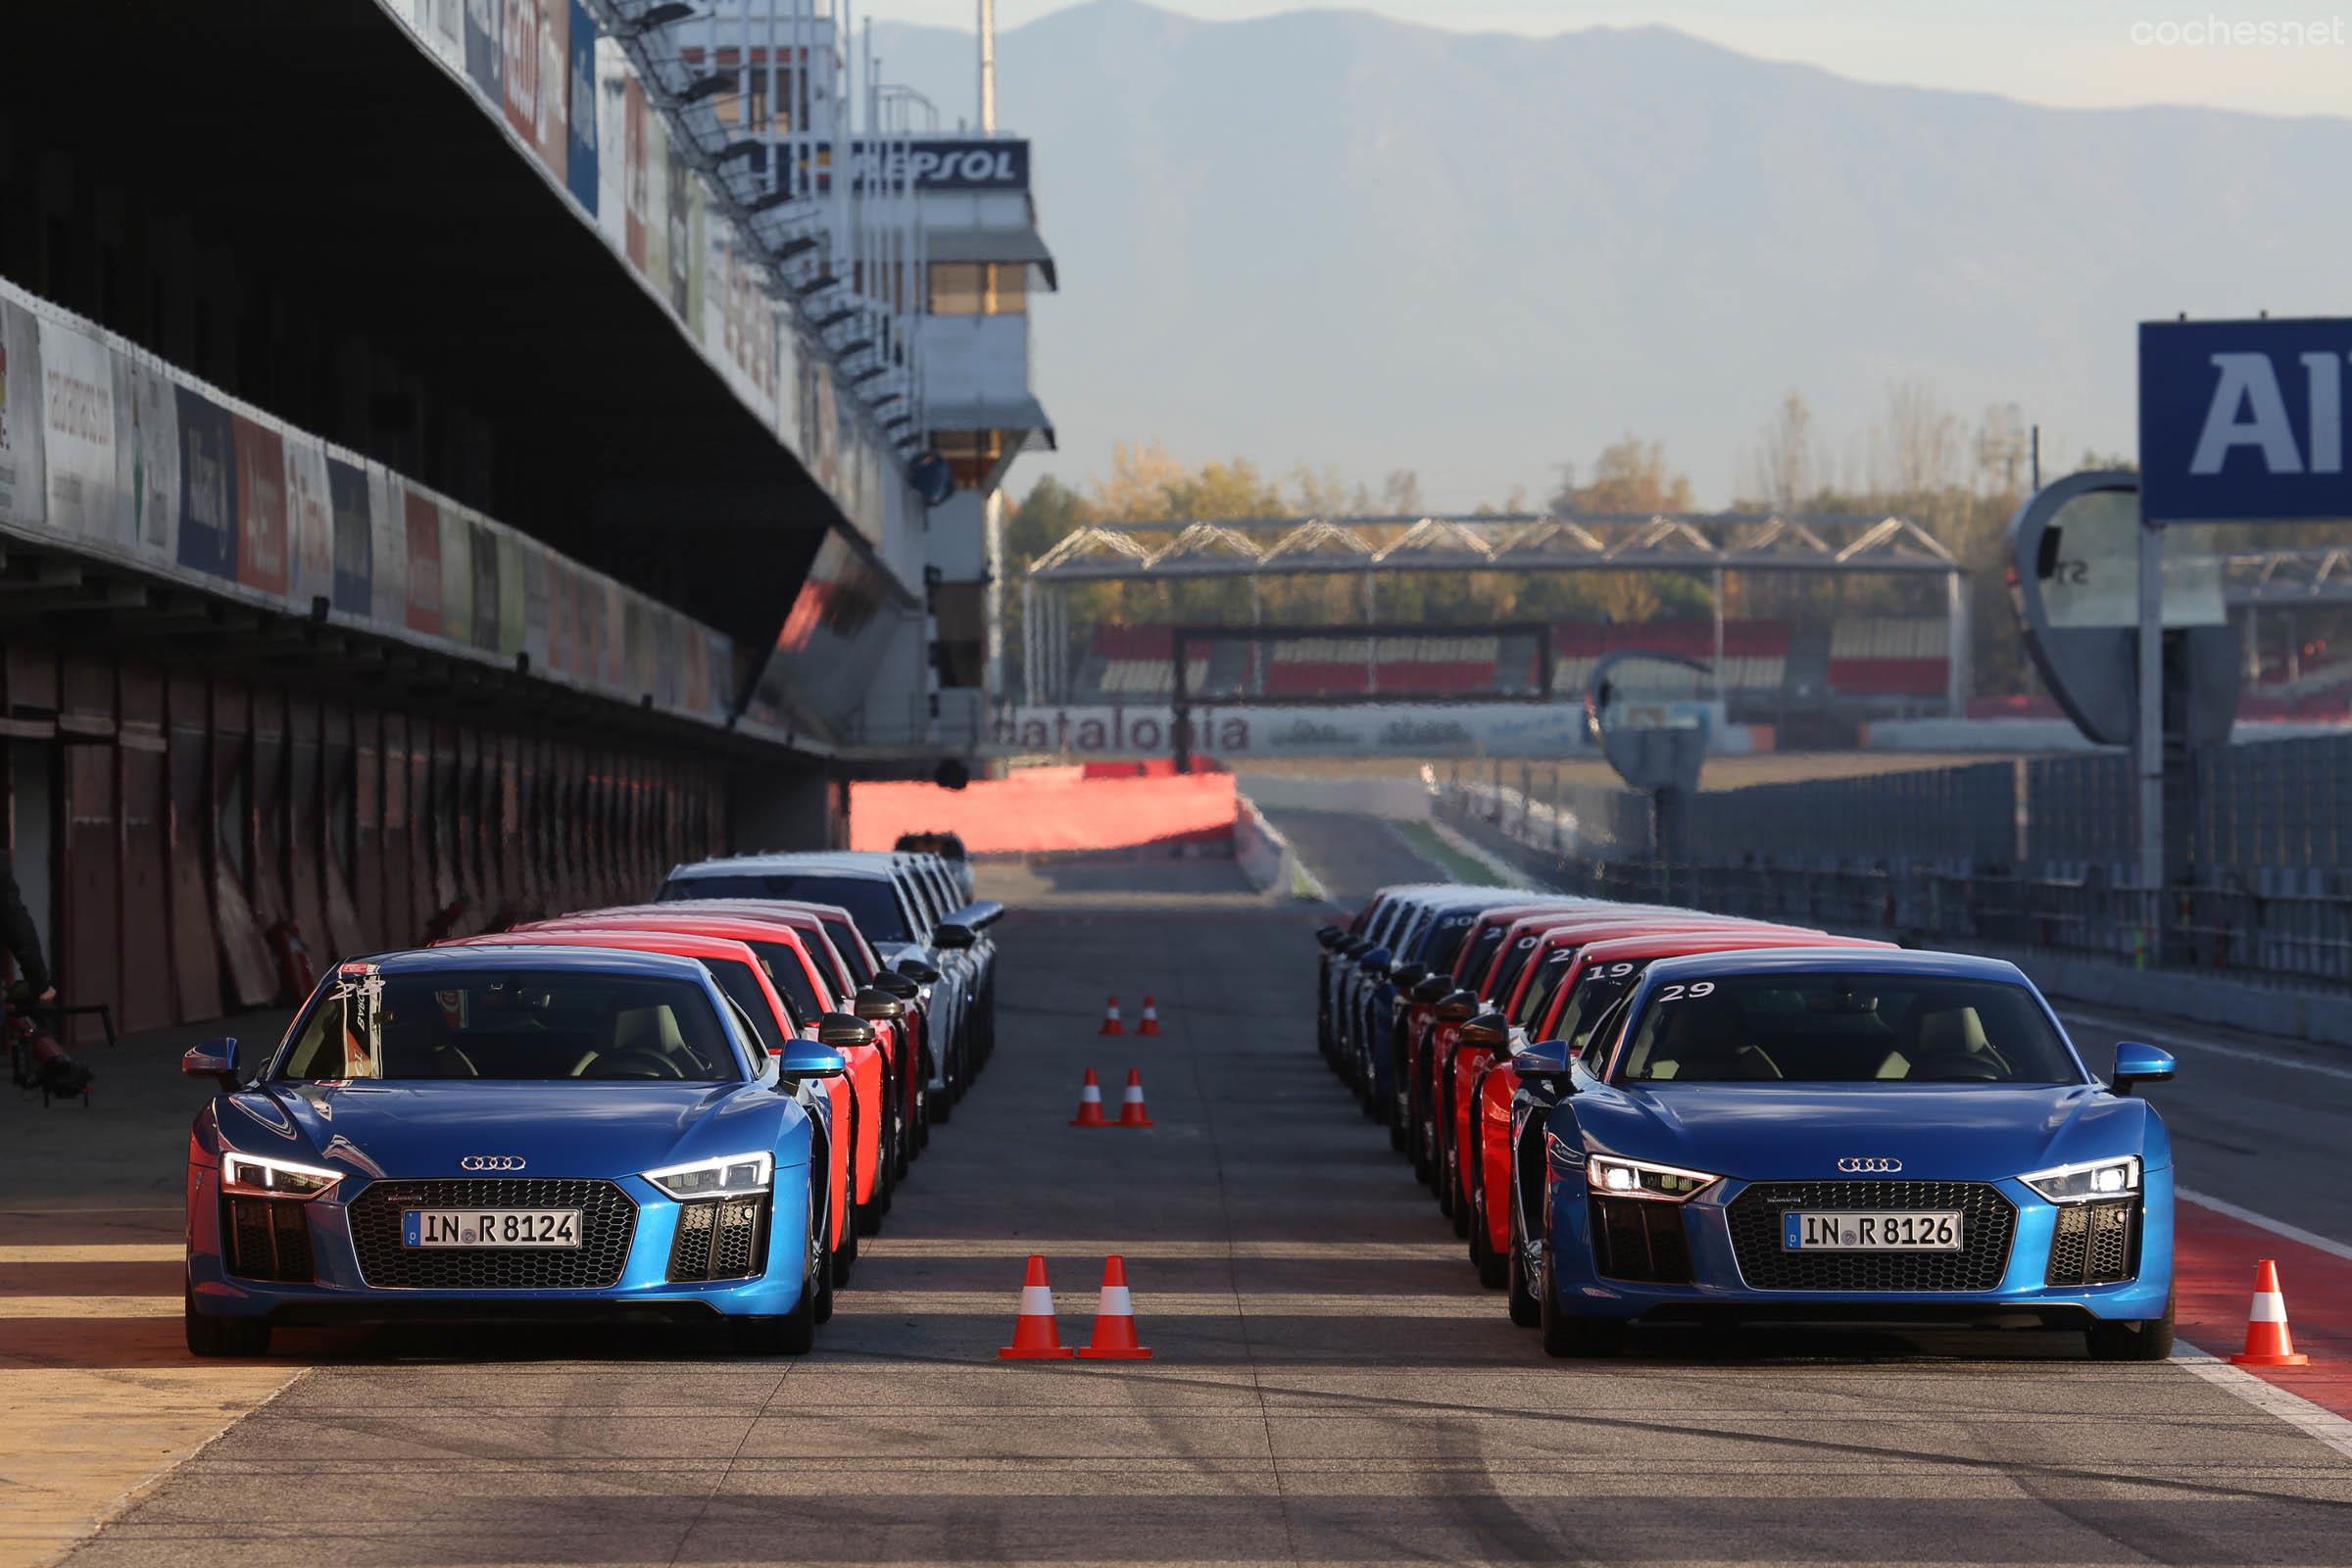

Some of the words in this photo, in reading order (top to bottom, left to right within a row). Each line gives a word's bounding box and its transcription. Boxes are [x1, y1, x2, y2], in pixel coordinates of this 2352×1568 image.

[1483, 926, 1506, 940] 2
[1548, 948, 1576, 963] 2
[1587, 962, 1634, 981] 19
[1659, 981, 1716, 1003] 29
[424, 1215, 460, 1243] IN
[479, 1215, 496, 1243] R
[503, 1215, 573, 1243] 8124
[1805, 1217, 1839, 1245] IN
[1859, 1217, 1878, 1245] R
[1883, 1217, 1954, 1245] 8126
